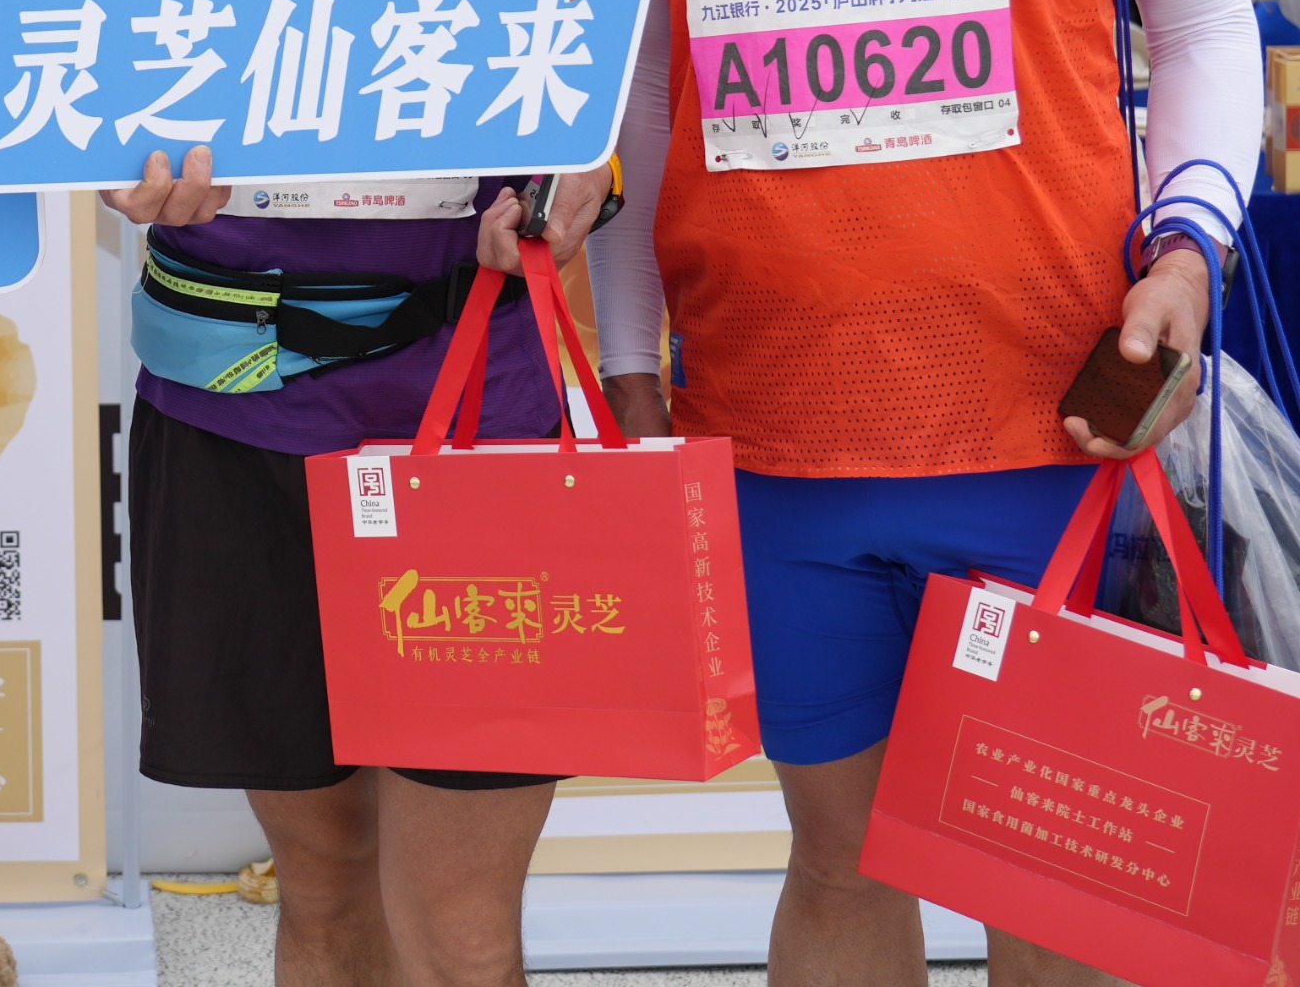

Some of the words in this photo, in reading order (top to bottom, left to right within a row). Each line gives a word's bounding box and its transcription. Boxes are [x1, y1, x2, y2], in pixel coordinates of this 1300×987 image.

[713, 20, 992, 110] A10620
[940, 100, 994, 115] 存取包窗口
[998, 98, 1011, 108] 04
[840, 114, 850, 124] 完
[890, 110, 901, 120] 收
[792, 141, 829, 151] 洋河股份
[884, 134, 933, 148] 青岛啤酒
[272, 192, 309, 202] 洋河股份
[361, 195, 406, 206] 青岛啤酒
[360, 499, 380, 507] China
[684, 481, 724, 678] 国家高新技术企业
[969, 634, 990, 646] China
[411, 645, 541, 664] 有机灵芝全产业链
[974, 742, 1186, 830] 农业产业化国家重点龙头企业
[1009, 785, 1134, 843] 仙客来院士工作站
[962, 798, 1171, 888] 国家食用菌加工技术研发分中心
